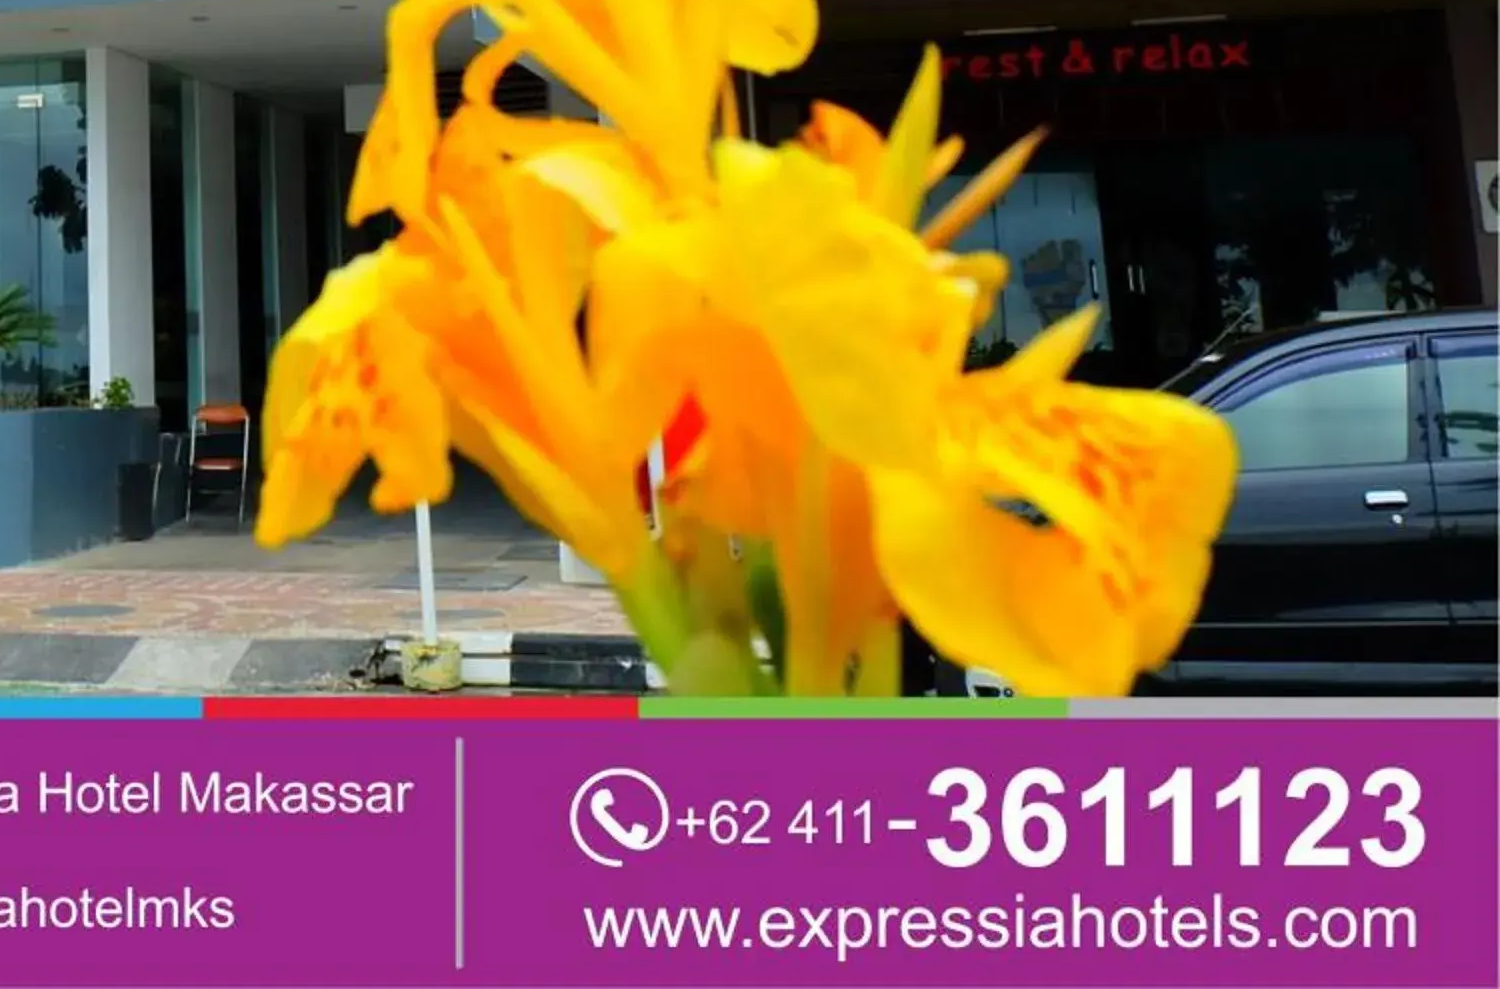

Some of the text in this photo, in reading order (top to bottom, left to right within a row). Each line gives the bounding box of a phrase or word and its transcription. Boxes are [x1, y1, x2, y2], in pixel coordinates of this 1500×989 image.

[938, 33, 1250, 79] rest & relax
